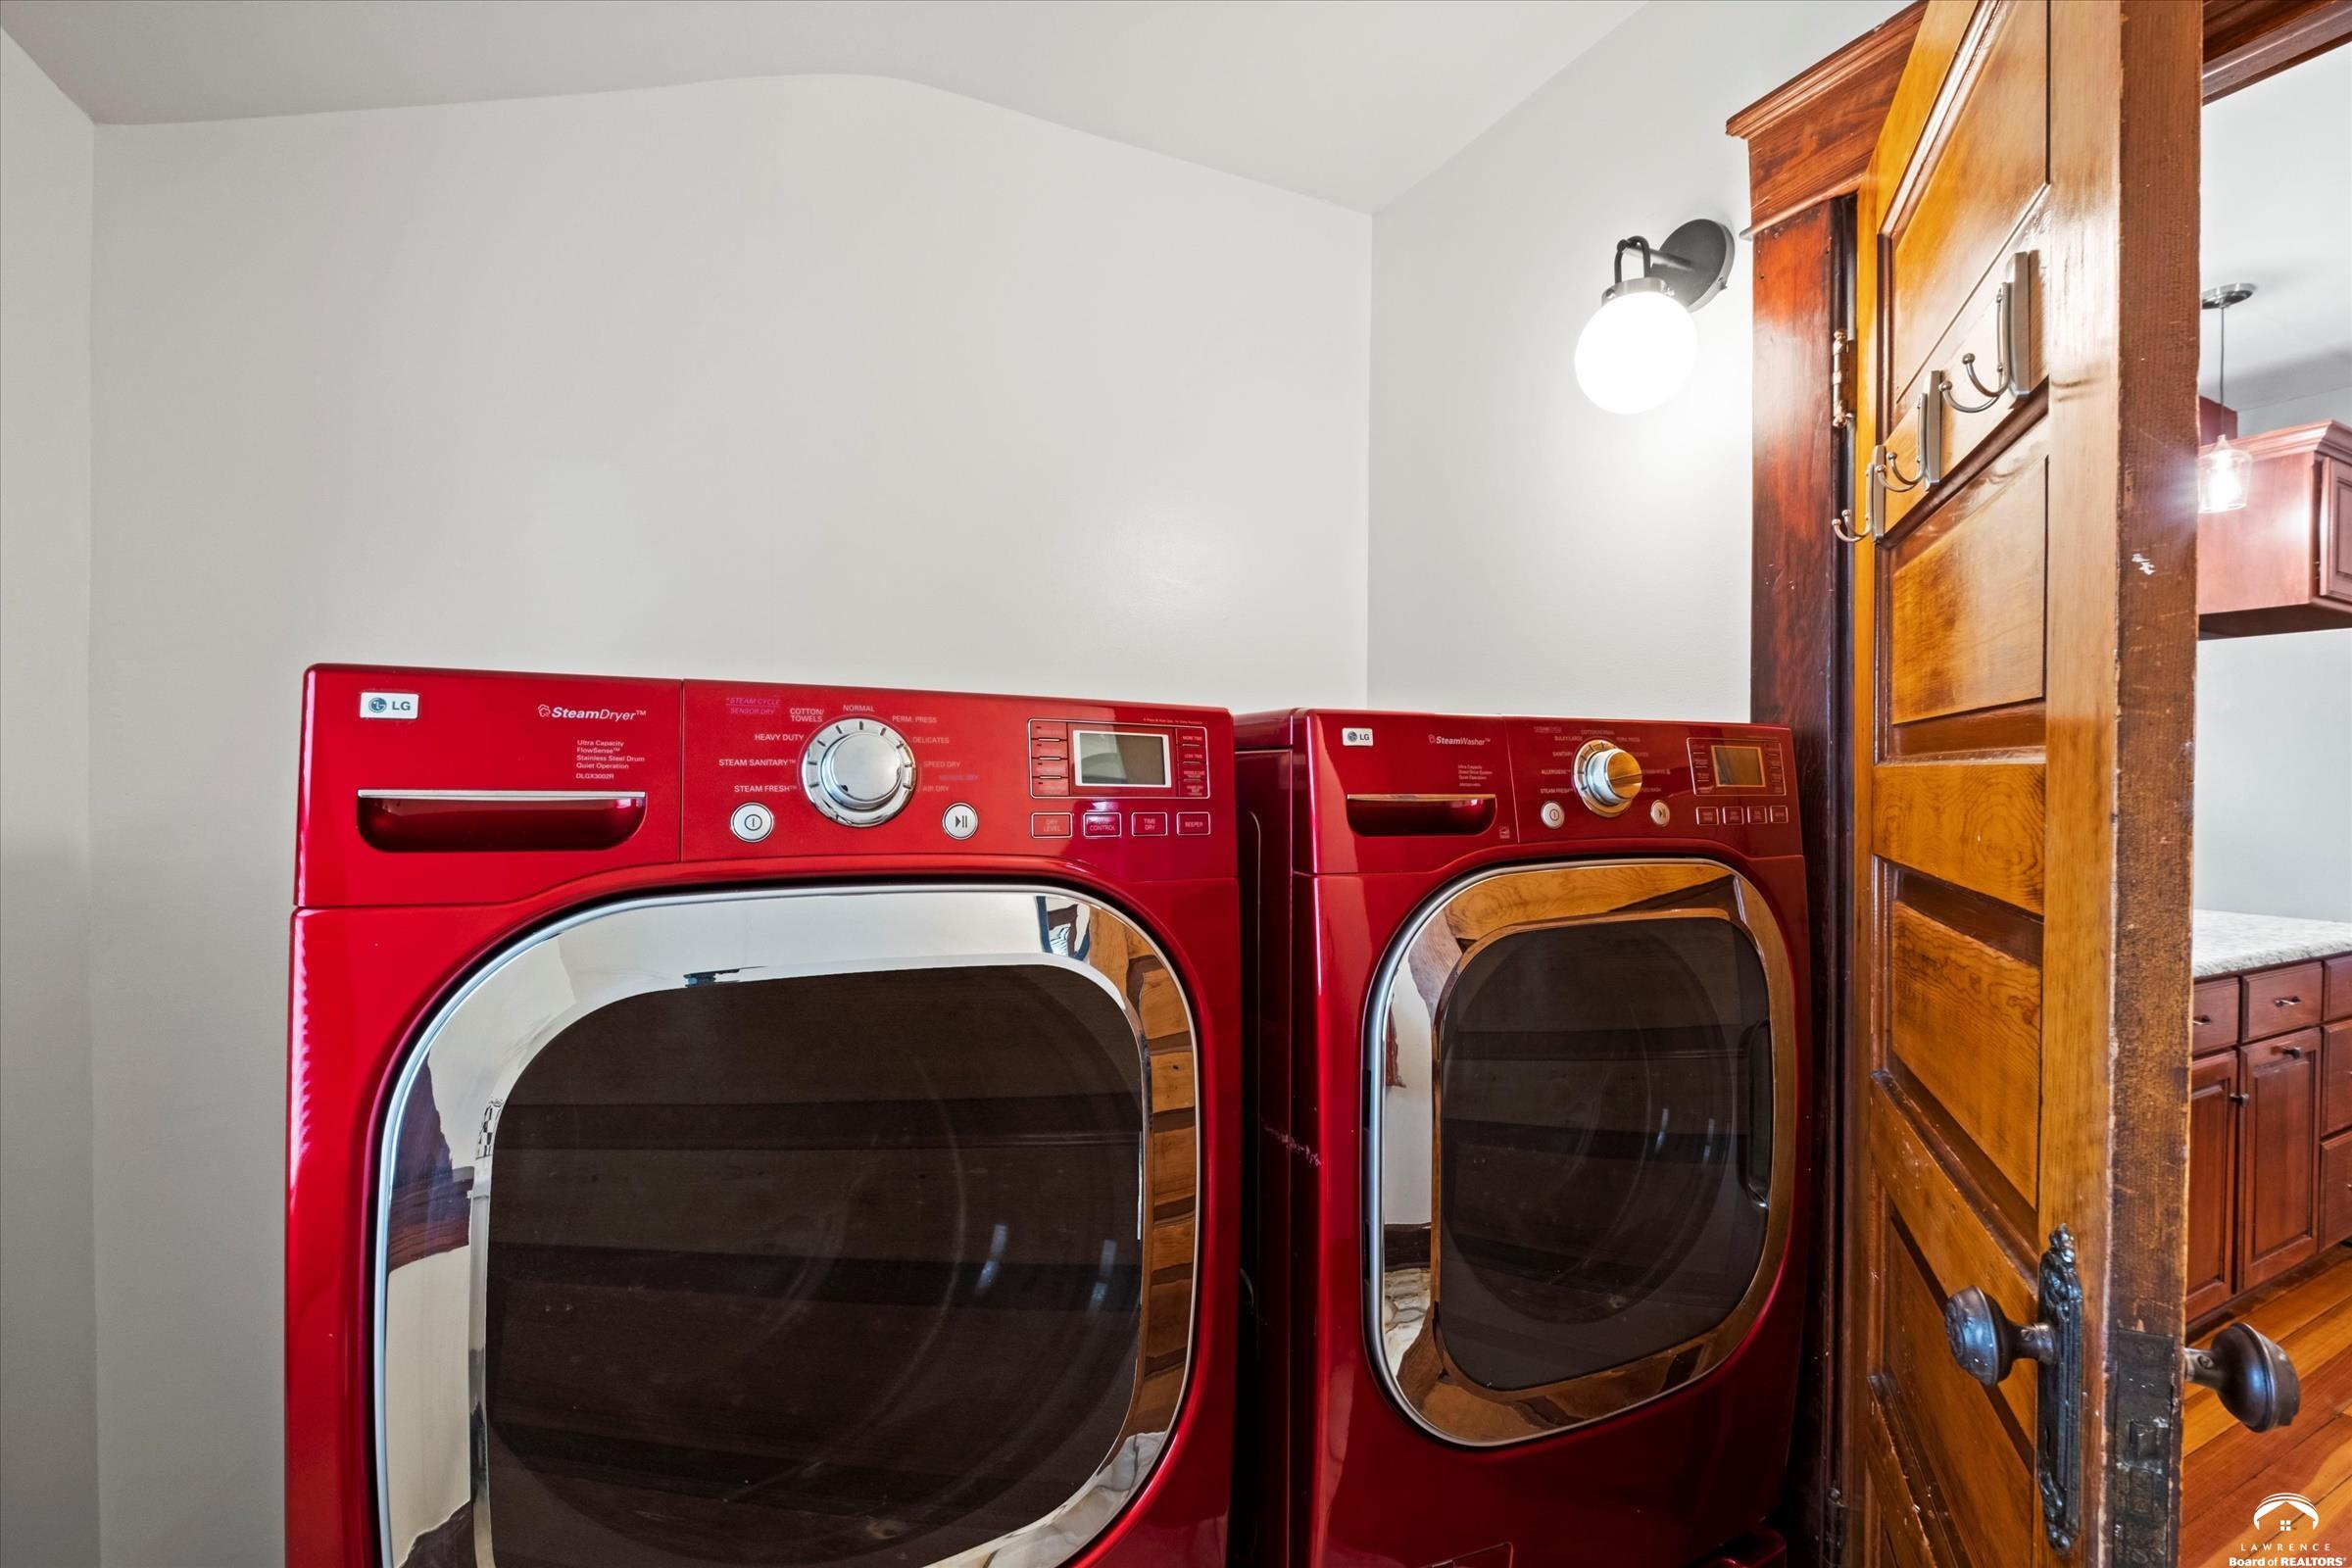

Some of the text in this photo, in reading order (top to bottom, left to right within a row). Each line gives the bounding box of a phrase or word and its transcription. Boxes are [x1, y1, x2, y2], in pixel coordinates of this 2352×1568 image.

[391, 700, 412, 711] LG
[914, 715, 938, 724] PRESS
[782, 733, 805, 742] DUTY
[595, 739, 625, 748] Capacity
[718, 759, 748, 767] STEAM
